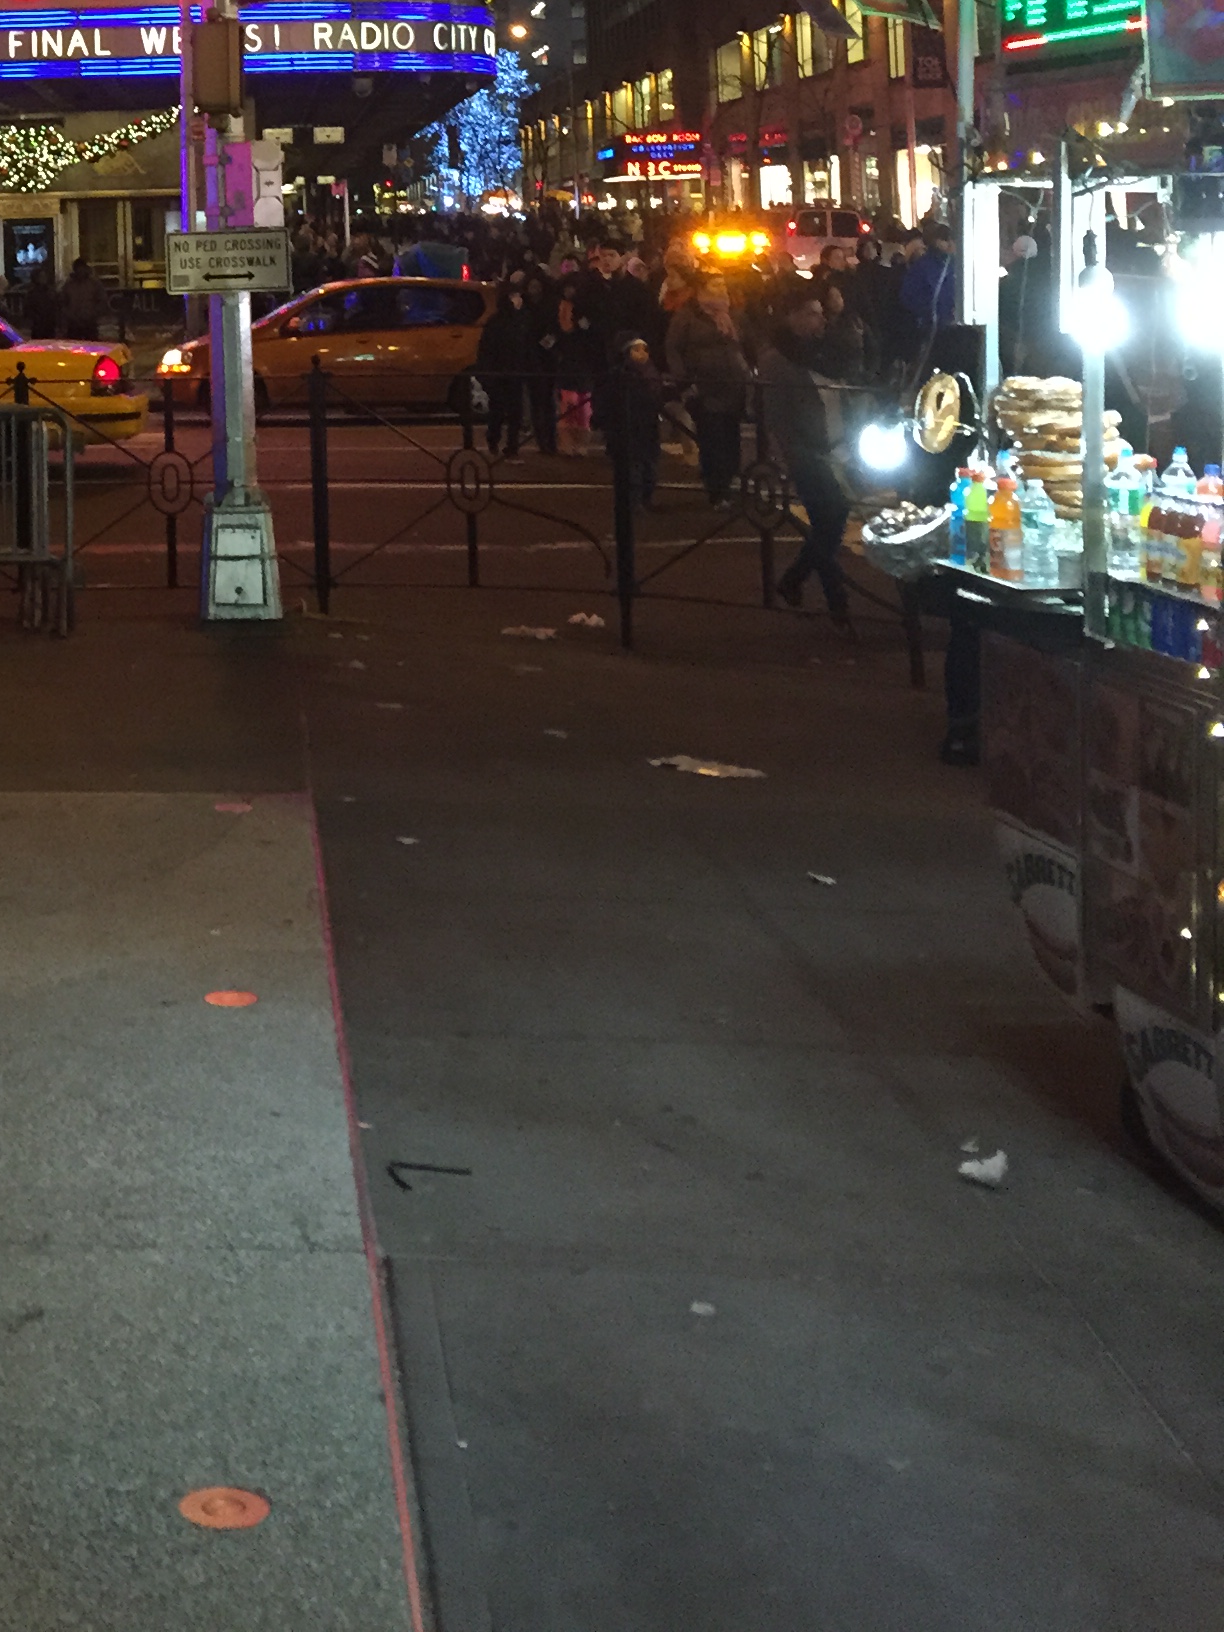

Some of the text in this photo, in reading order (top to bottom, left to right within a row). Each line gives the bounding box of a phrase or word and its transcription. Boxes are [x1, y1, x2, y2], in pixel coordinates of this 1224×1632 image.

[7, 26, 112, 59] FINAL
[313, 22, 415, 51] RADIO
[433, 22, 478, 52] CITY
[174, 237, 282, 253] NO PED CROSSING
[179, 255, 277, 270] USE CROSSWALK
